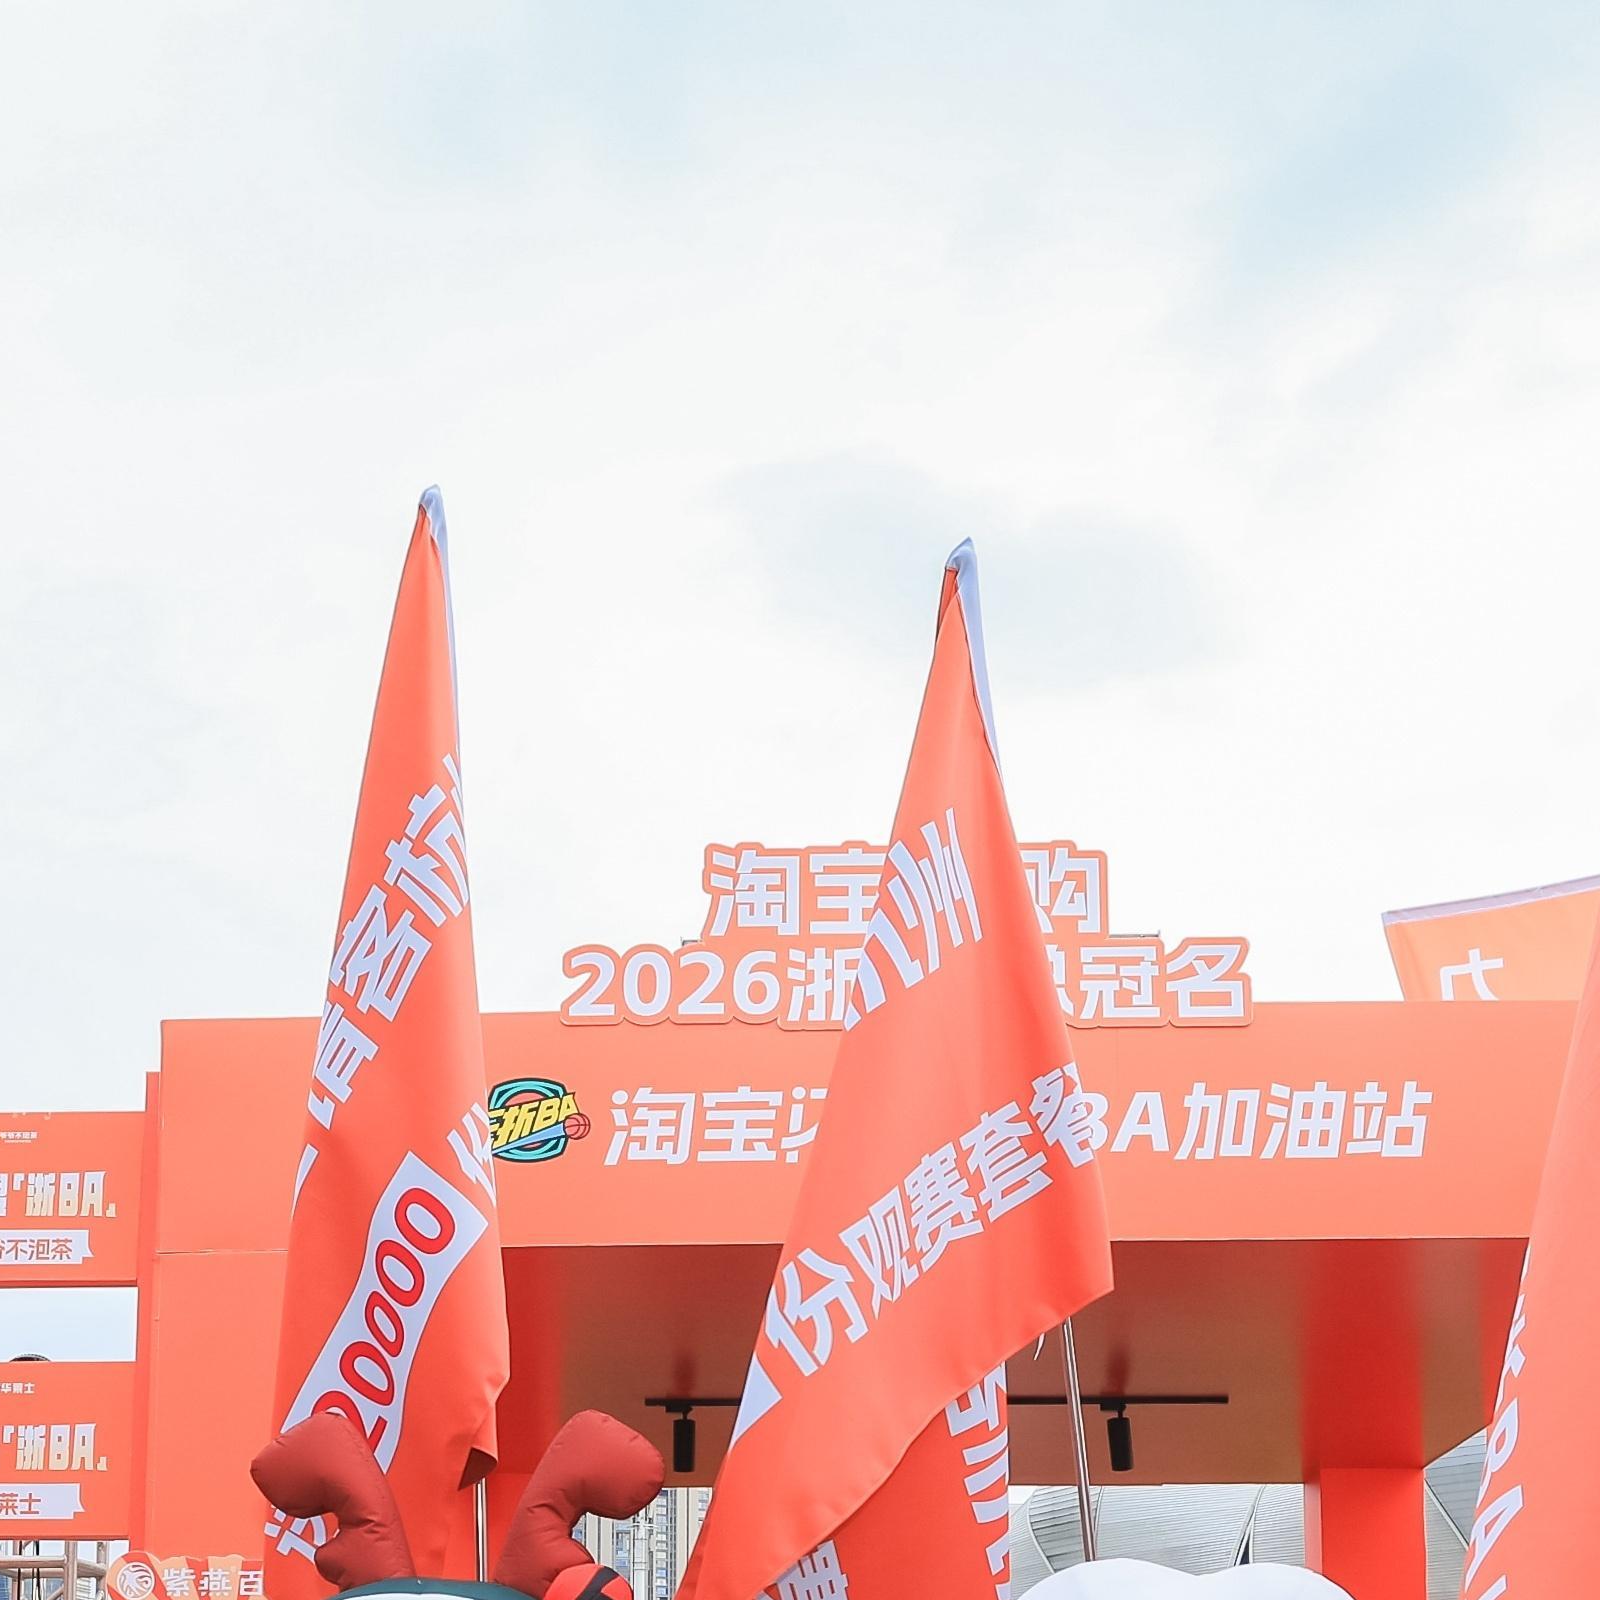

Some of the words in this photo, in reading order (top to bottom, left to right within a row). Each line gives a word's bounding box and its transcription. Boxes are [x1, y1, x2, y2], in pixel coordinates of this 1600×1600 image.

[707, 847, 1101, 937] 淘宝购
[568, 945, 1248, 1022] 2026浙冠名
[601, 1081, 1433, 1168] 淘宝BA加油站
